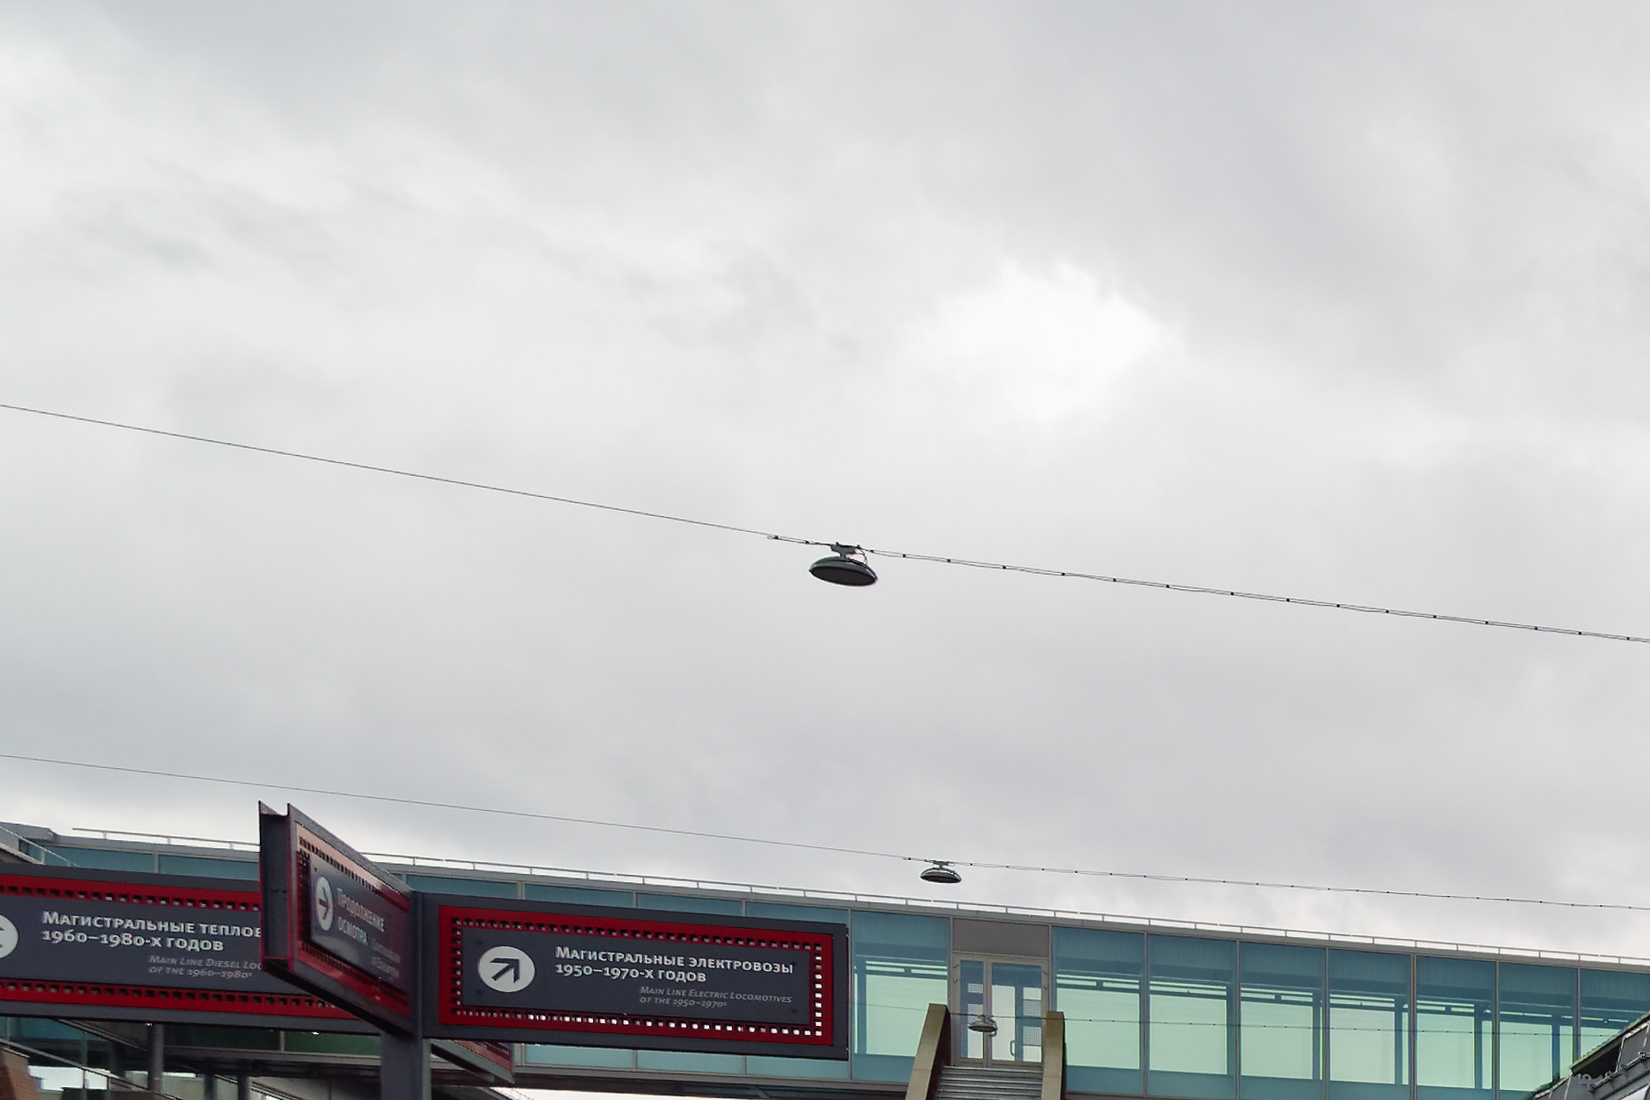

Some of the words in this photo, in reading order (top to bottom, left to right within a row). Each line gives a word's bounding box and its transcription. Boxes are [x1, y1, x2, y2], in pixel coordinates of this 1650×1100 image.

[42, 910, 196, 934] МАГИСТРАЛЬНЫЕ
[166, 937, 224, 952] ГОДОВ
[180, 957, 203, 967] LINE
[205, 958, 240, 969] DIESEL
[555, 946, 685, 967] МАГИСТРАЛЬНЫЕ
[688, 957, 794, 974] ЭЛЕКТРОВОЗЫ
[658, 969, 707, 983] ГОДОВ
[640, 985, 664, 995] MAIN
[666, 987, 687, 996] LINE
[688, 989, 729, 999] ELECTRIC
[729, 991, 793, 1003] LOCOMOTIVES
[654, 997, 670, 1005] THE
